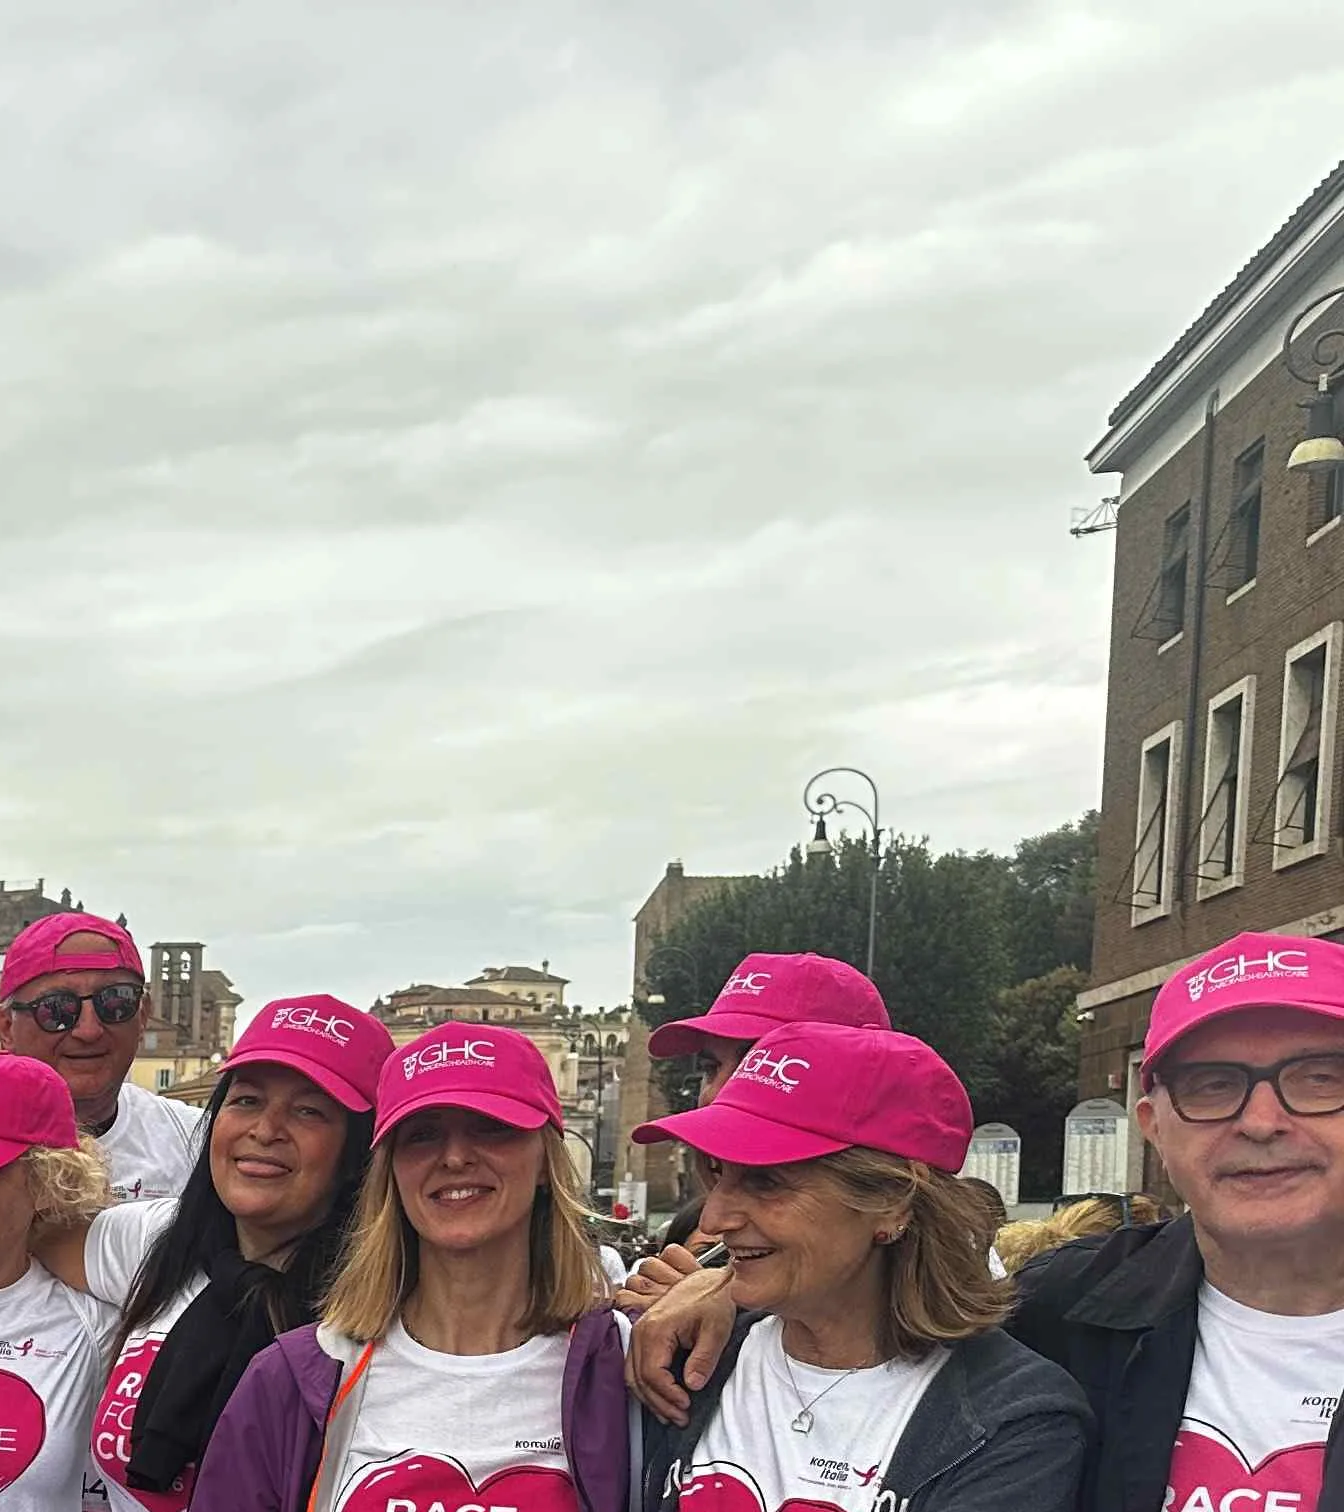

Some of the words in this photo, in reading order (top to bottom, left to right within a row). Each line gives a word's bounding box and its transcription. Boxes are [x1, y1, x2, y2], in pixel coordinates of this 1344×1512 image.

[1211, 941, 1309, 979] GHC
[287, 1007, 355, 1041] GHC
[414, 1039, 496, 1069] GHC
[744, 1048, 811, 1086] GHC
